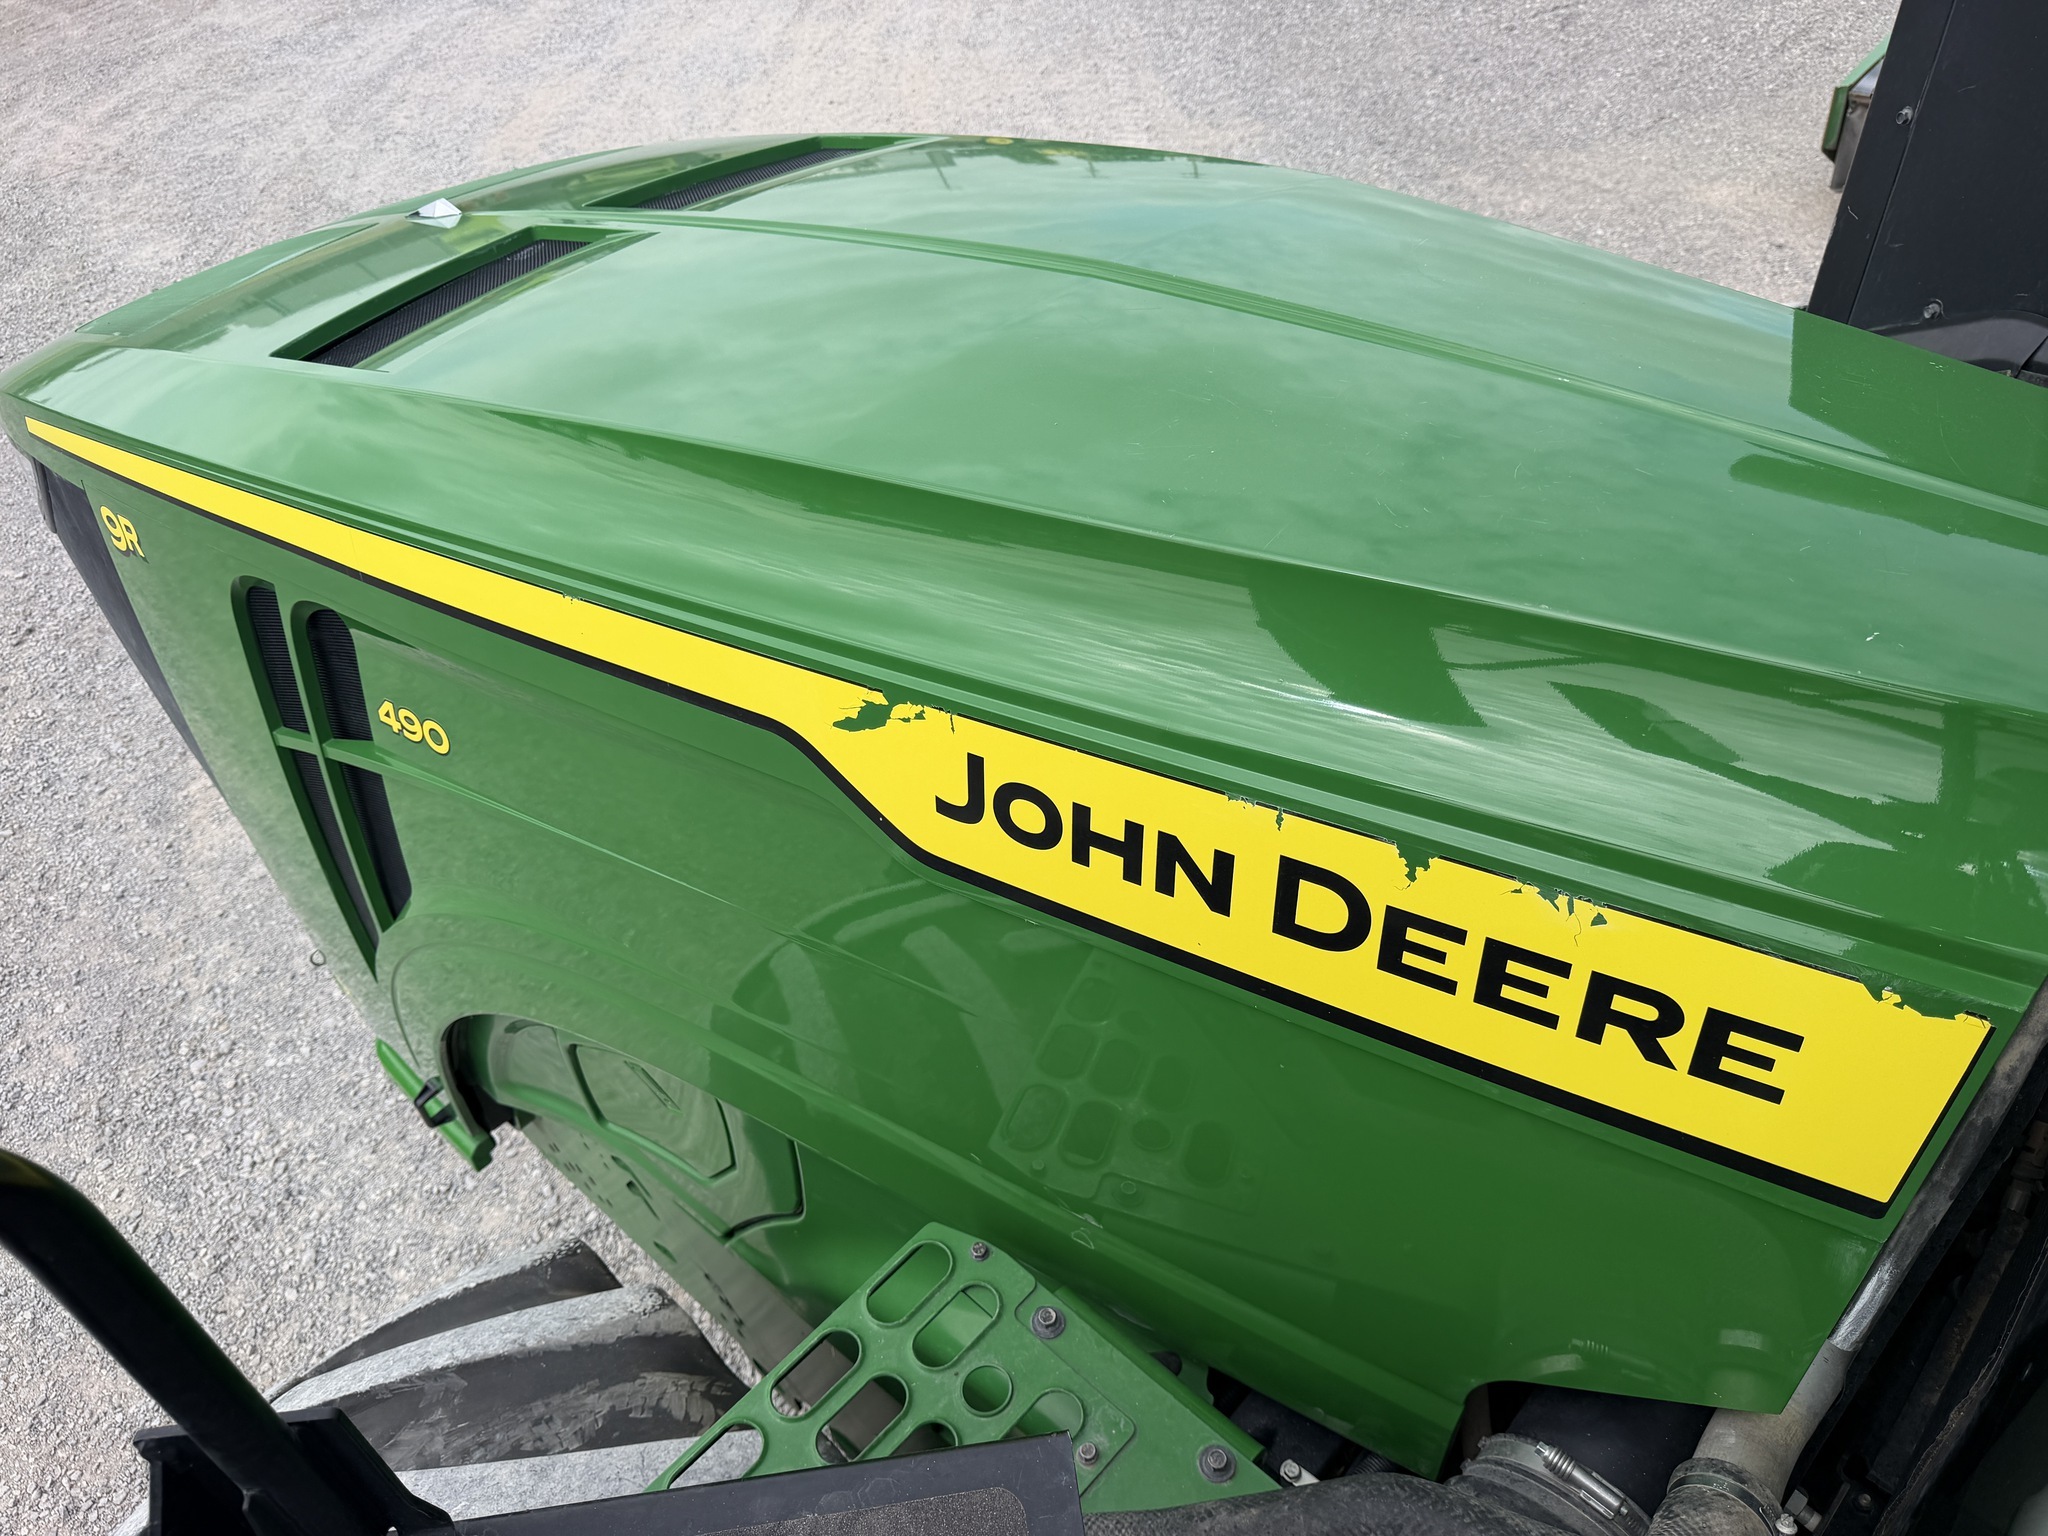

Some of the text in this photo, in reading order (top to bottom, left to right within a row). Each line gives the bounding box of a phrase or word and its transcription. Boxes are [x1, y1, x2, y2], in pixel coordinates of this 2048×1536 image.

[100, 504, 146, 558] 9R
[377, 698, 451, 756] 490
[935, 752, 1805, 1106] JOHN DEERE
